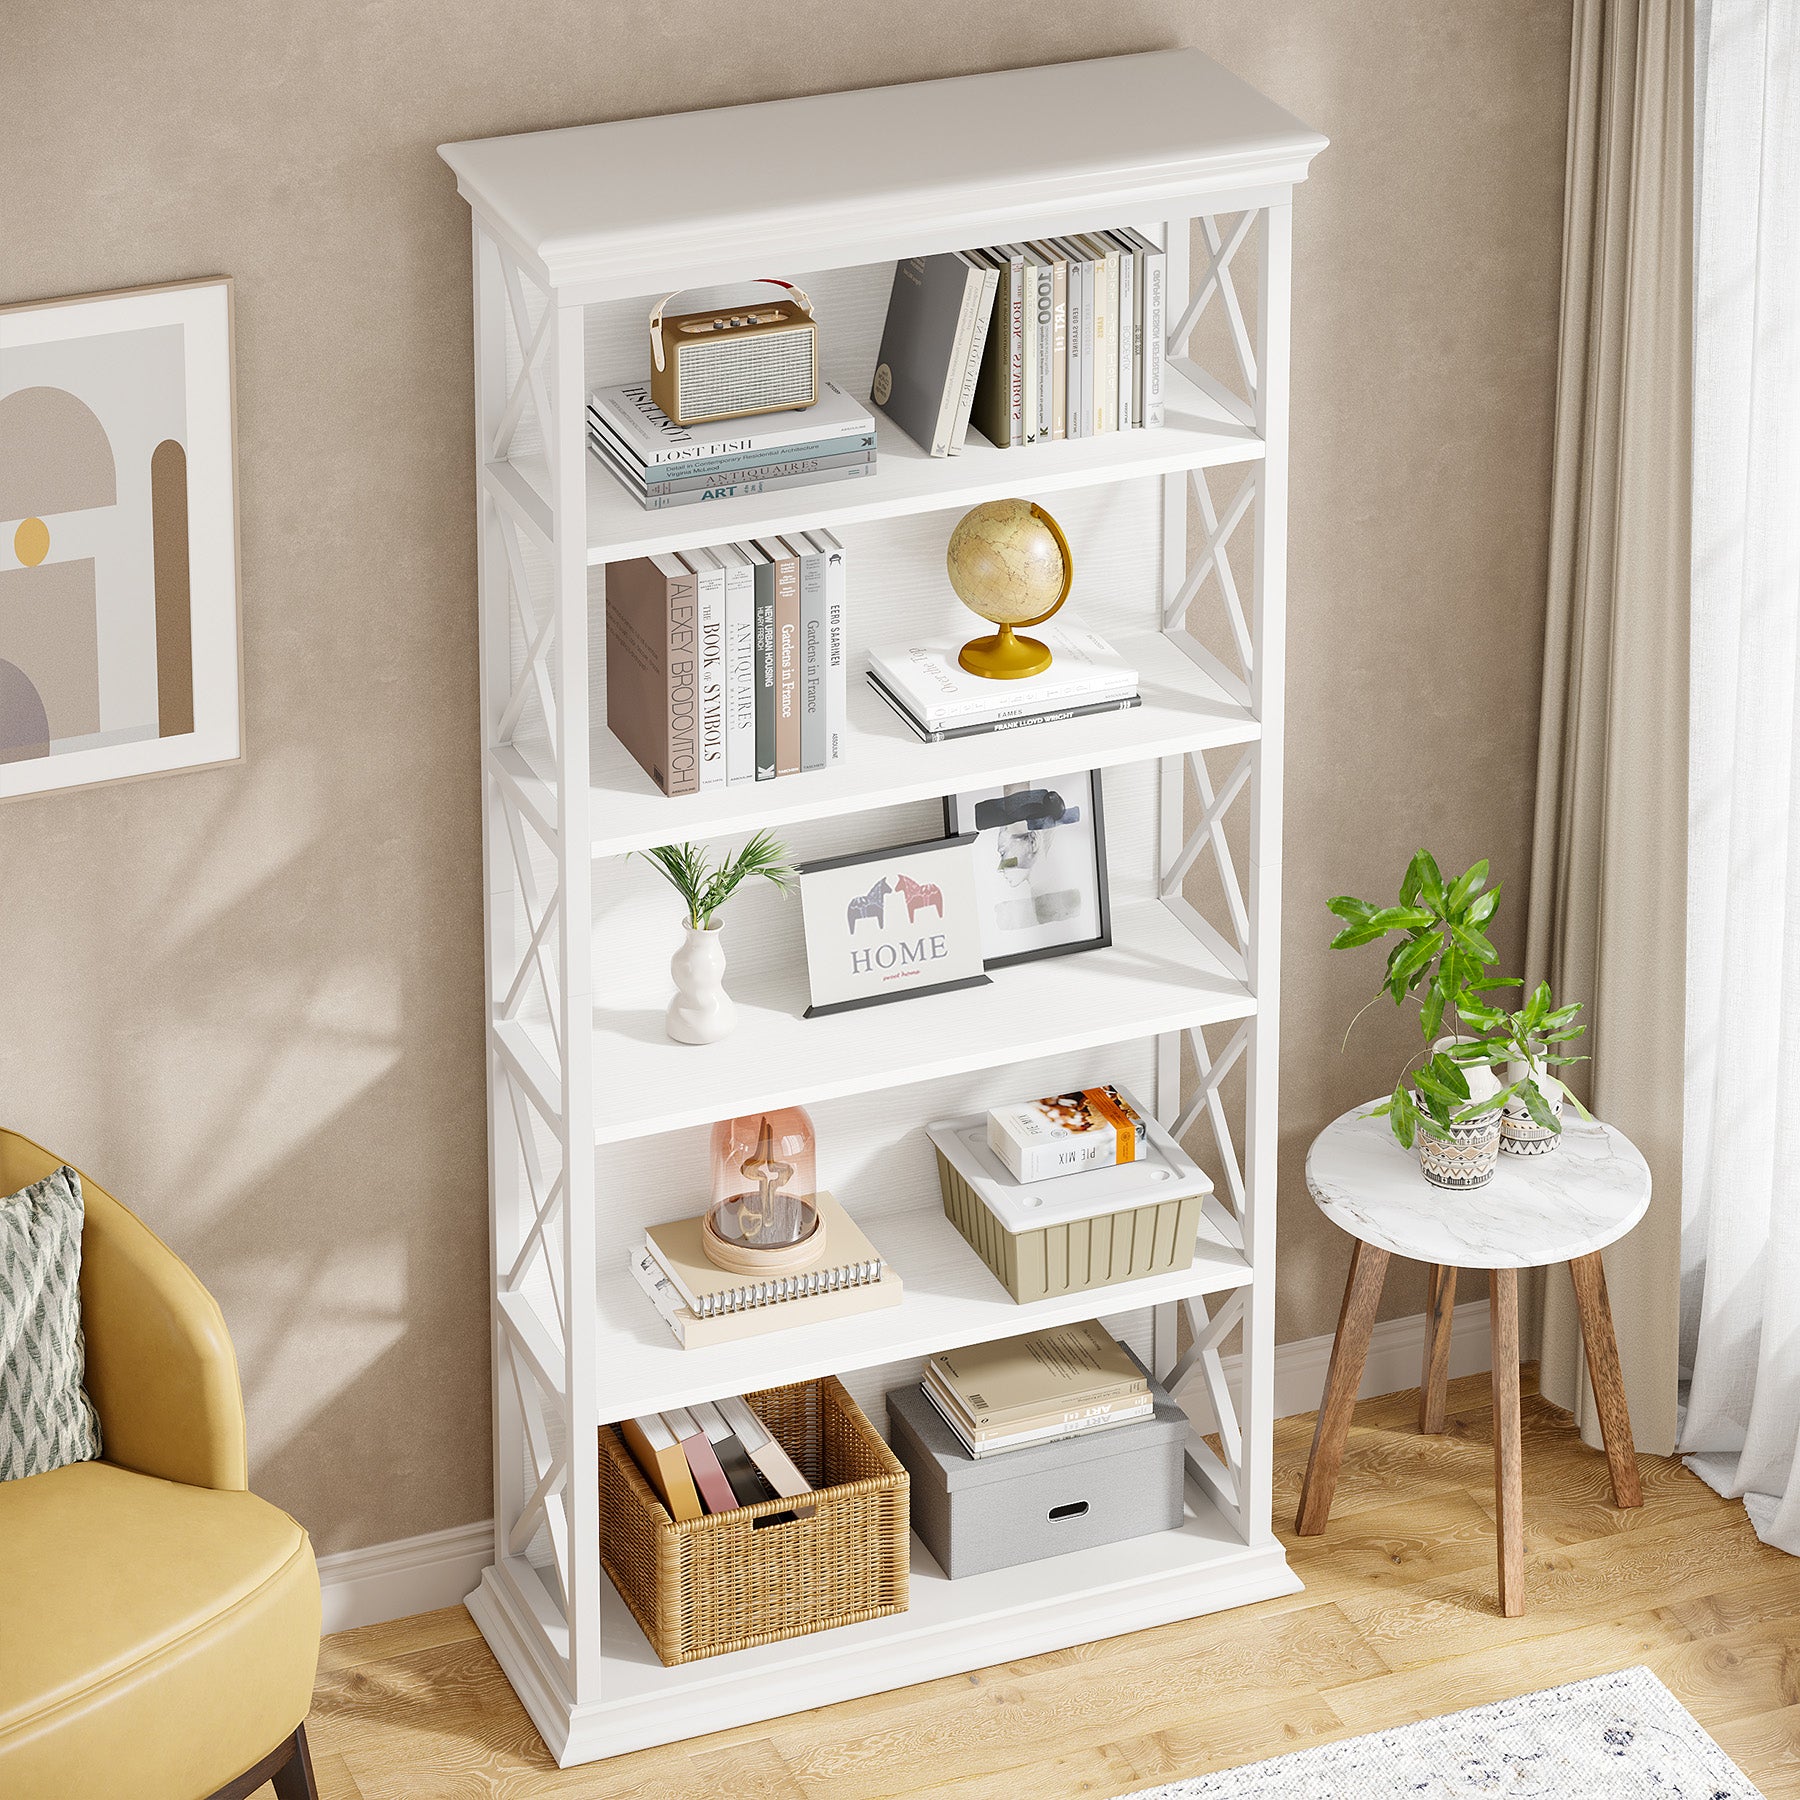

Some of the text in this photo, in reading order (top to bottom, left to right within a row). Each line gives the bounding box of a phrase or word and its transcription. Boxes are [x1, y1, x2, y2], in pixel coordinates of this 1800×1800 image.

[622, 387, 661, 412] FISH
[647, 415, 693, 442] LOST
[656, 440, 752, 463] LOST FISH
[666, 464, 686, 472] Detail
[694, 456, 741, 469] Contemporary
[742, 450, 779, 460] Residential
[780, 444, 820, 454] Architecture
[666, 465, 720, 478] Virginia McLeod
[705, 460, 819, 484] ANTIQUAIRES
[701, 485, 738, 501] ART
[703, 605, 711, 620] THE
[703, 623, 721, 668] BOOK
[764, 605, 774, 687] NEW URBAN HOUSING
[830, 605, 841, 666] EERO SAARINEN
[704, 671, 711, 682] OF
[734, 623, 752, 730] ANTIQUAIRES
[781, 624, 795, 718] Gardens in France
[807, 620, 820, 713] Gardens in France
[671, 583, 694, 784] ALEXEY BRODOVITCH
[704, 684, 721, 762] SYMBOLS
[994, 712, 1074, 731] FRANK LLOYD WRIGHT
[998, 709, 1023, 718] EAMES
[851, 935, 948, 974] HOME
[1018, 1114, 1034, 1125] MIX
[1027, 1124, 1042, 1135] PIE
[1059, 1147, 1096, 1165] PIE MIX
[1084, 1404, 1112, 1417] ART
[1086, 1414, 1111, 1426] ART
